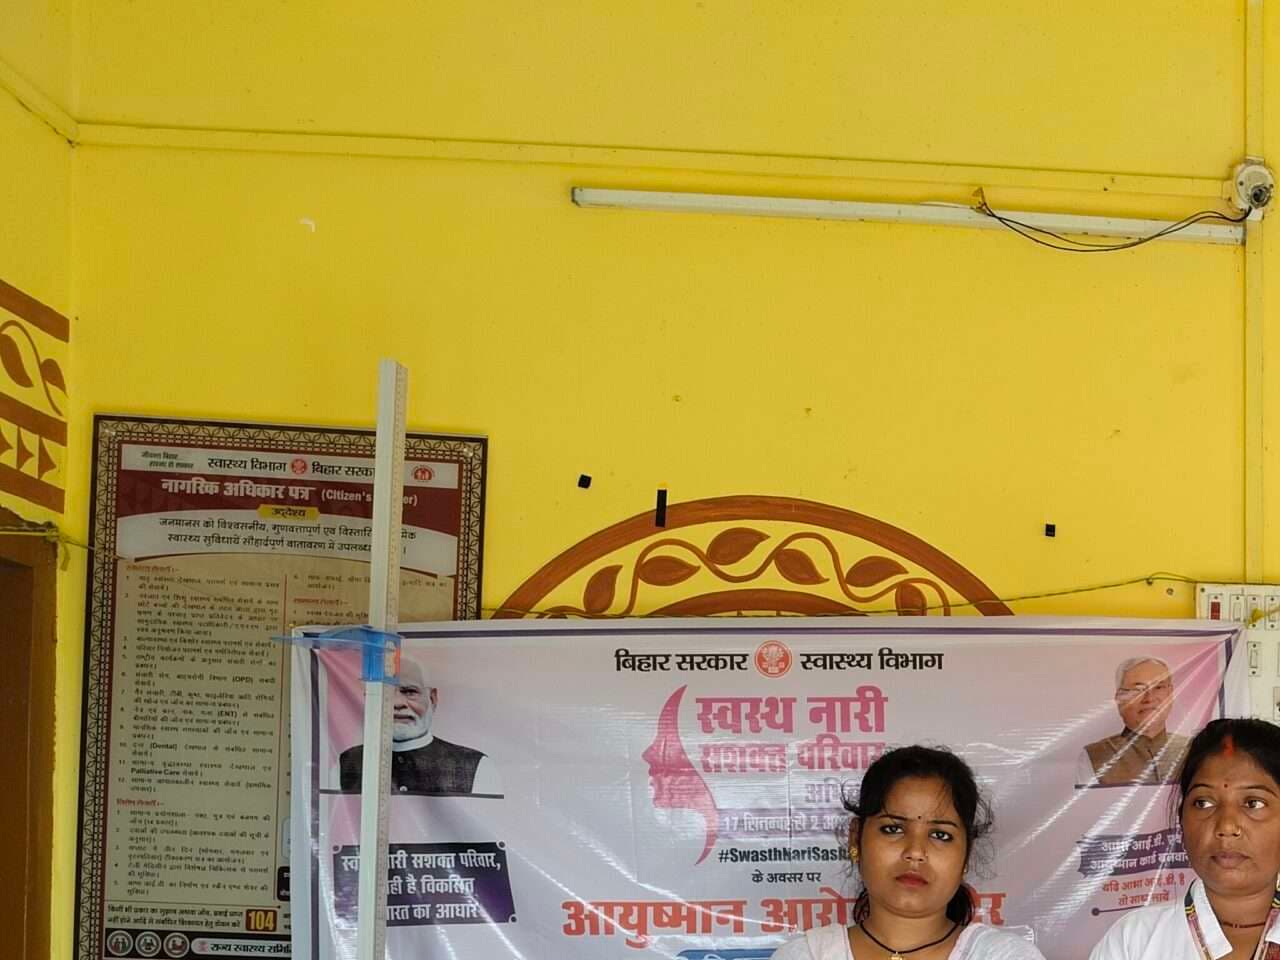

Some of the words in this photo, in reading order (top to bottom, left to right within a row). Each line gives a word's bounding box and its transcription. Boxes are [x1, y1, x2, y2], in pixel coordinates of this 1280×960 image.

[208, 458, 247, 471] स्वास्थ्य
[250, 458, 288, 472] विभाग
[312, 460, 343, 475] बिहार
[161, 476, 221, 496] नागरिक
[223, 479, 286, 499] अधिकार
[287, 485, 317, 501] पत्र
[203, 517, 214, 529] को
[615, 648, 672, 672] बिहार
[675, 652, 749, 671] सरकार
[800, 652, 873, 671] स्वास्थ्य
[878, 647, 944, 671] विभाग
[695, 697, 796, 734] स्वस्थ
[807, 685, 889, 734] नारी
[411, 852, 456, 870] सशक्त
[458, 849, 501, 871] परिवार,
[405, 873, 417, 895] है
[420, 873, 475, 895] विकसित
[751, 869, 764, 884] के
[766, 871, 803, 884] अवसर
[806, 871, 821, 882] पर
[248, 911, 274, 931] 104
[412, 903, 430, 920] का
[435, 903, 480, 920] आधार
[561, 898, 747, 949] आयुष्मान
